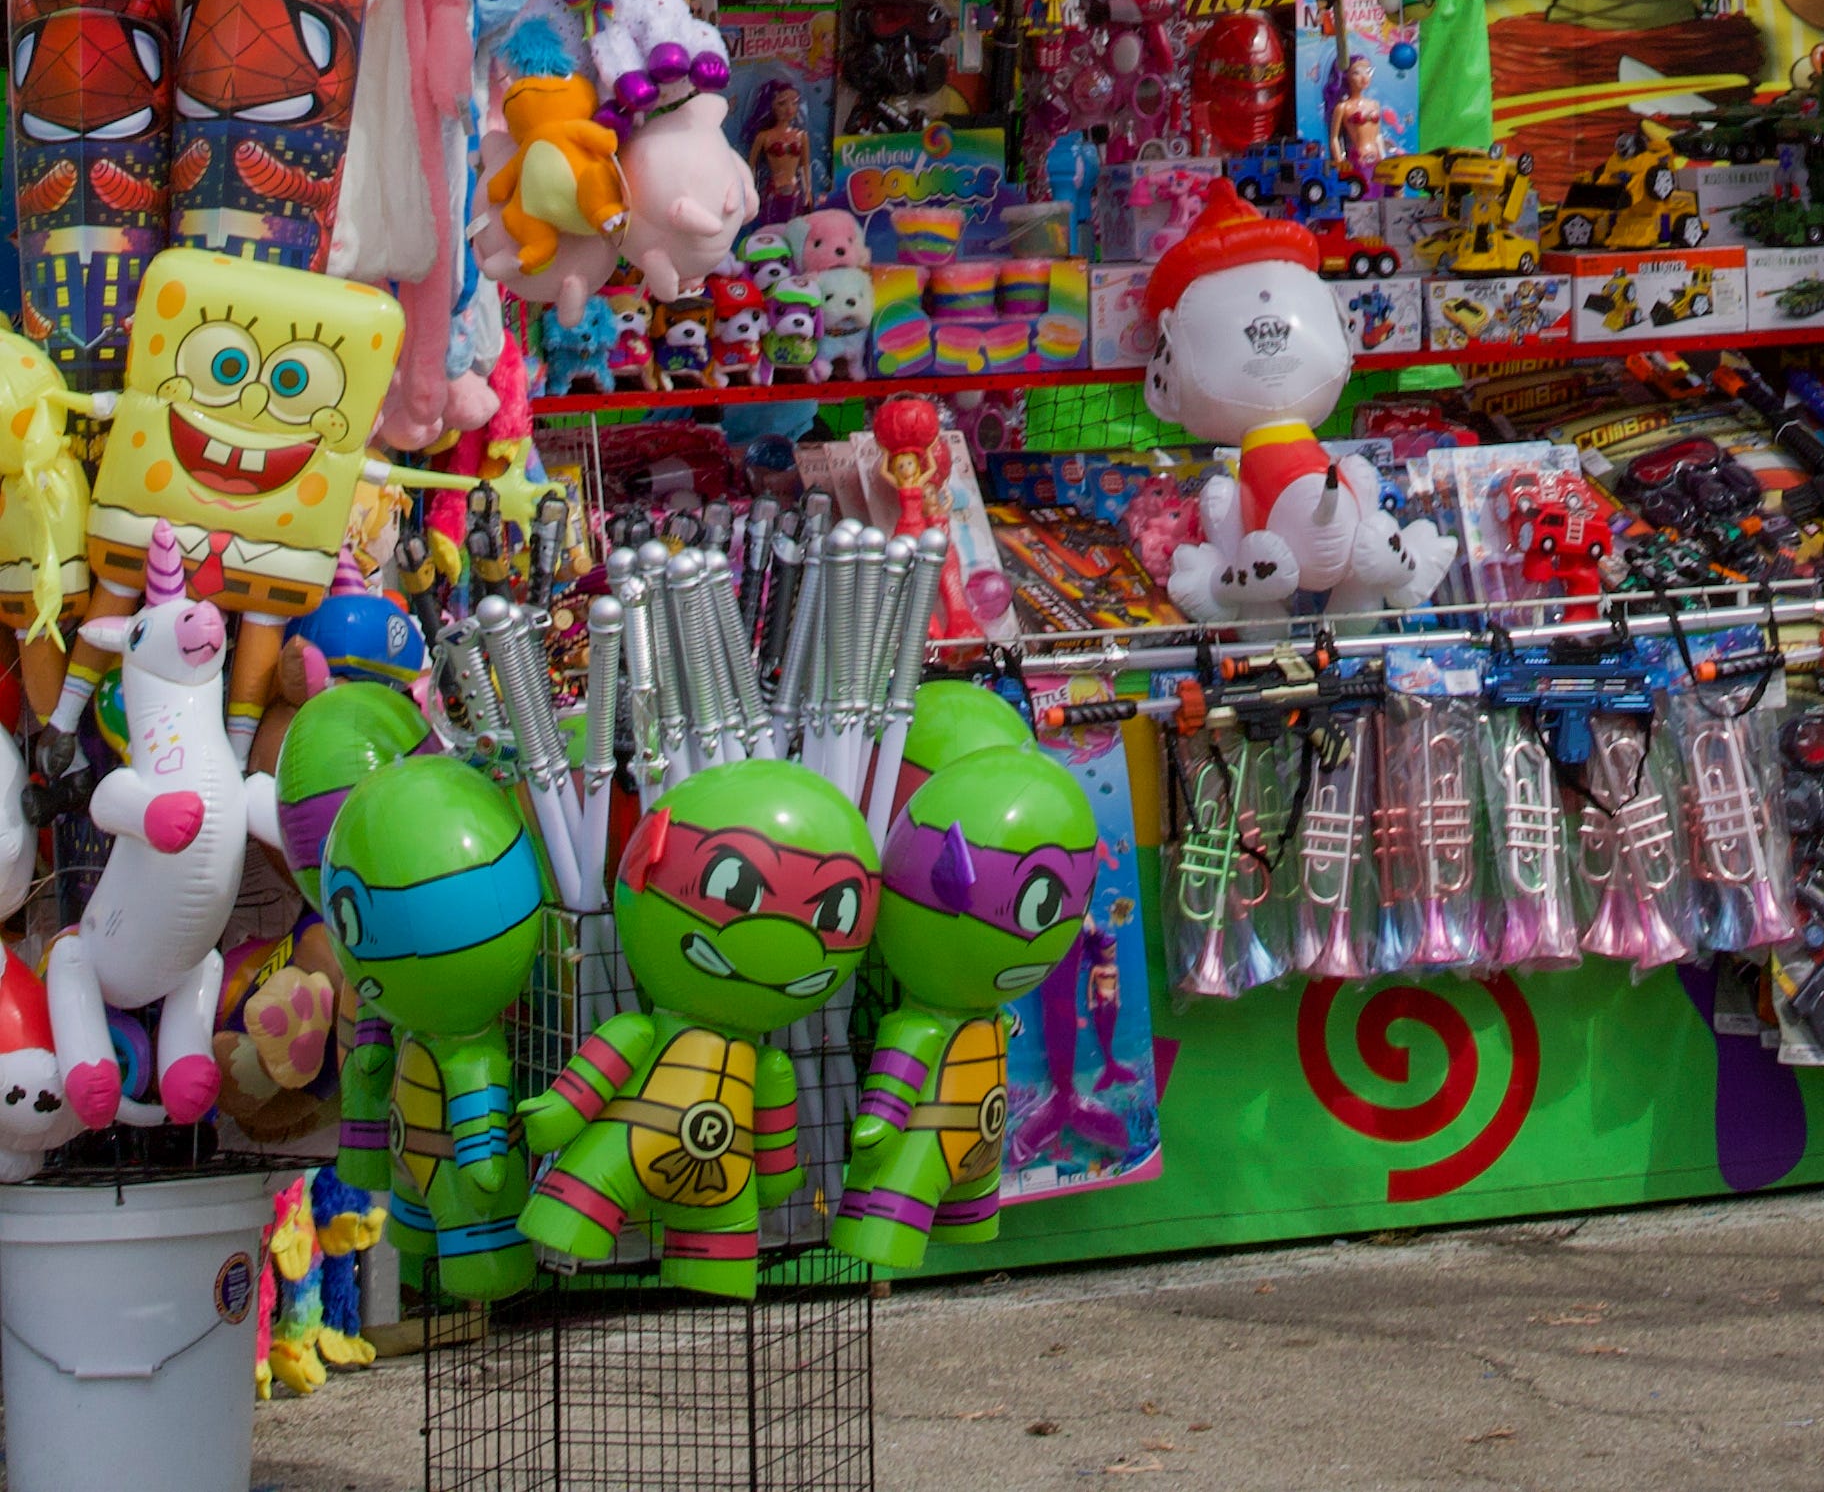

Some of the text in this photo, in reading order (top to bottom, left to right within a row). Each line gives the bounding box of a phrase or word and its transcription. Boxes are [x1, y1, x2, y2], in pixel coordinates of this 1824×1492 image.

[842, 141, 914, 167] Rainbow
[848, 164, 1002, 215] BOUNCE
[1573, 413, 1668, 451] COMBAT
[696, 1116, 724, 1146] R
